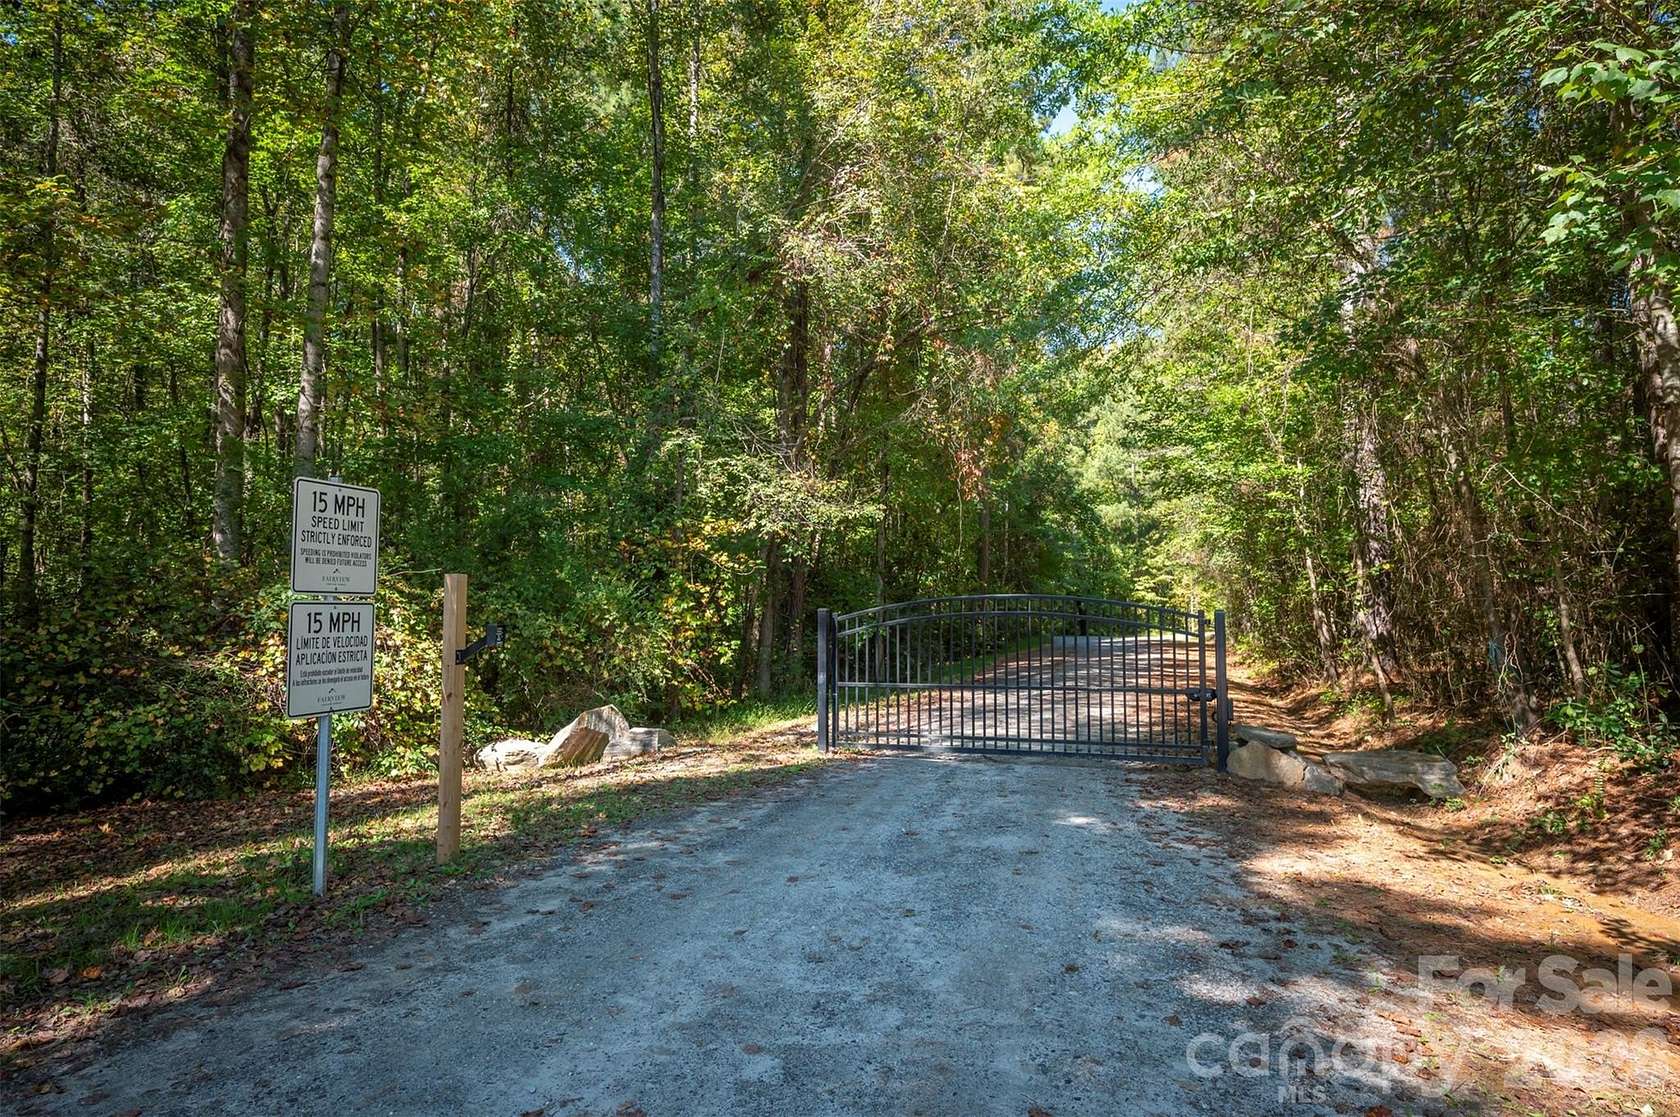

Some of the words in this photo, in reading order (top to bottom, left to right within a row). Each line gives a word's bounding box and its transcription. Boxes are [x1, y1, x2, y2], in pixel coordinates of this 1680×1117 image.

[312, 490, 328, 513] 15
[334, 493, 365, 518] MPH
[311, 515, 340, 530] SPEED
[342, 519, 364, 533] LIMIT
[301, 529, 336, 545] STRICTLY
[337, 533, 372, 548] ENFORCED
[307, 611, 323, 634] 15
[329, 611, 361, 633] MPH
[321, 636, 331, 649] DE
[333, 635, 368, 648] VELOCIDAD
[338, 649, 368, 663] ESTRICTA
